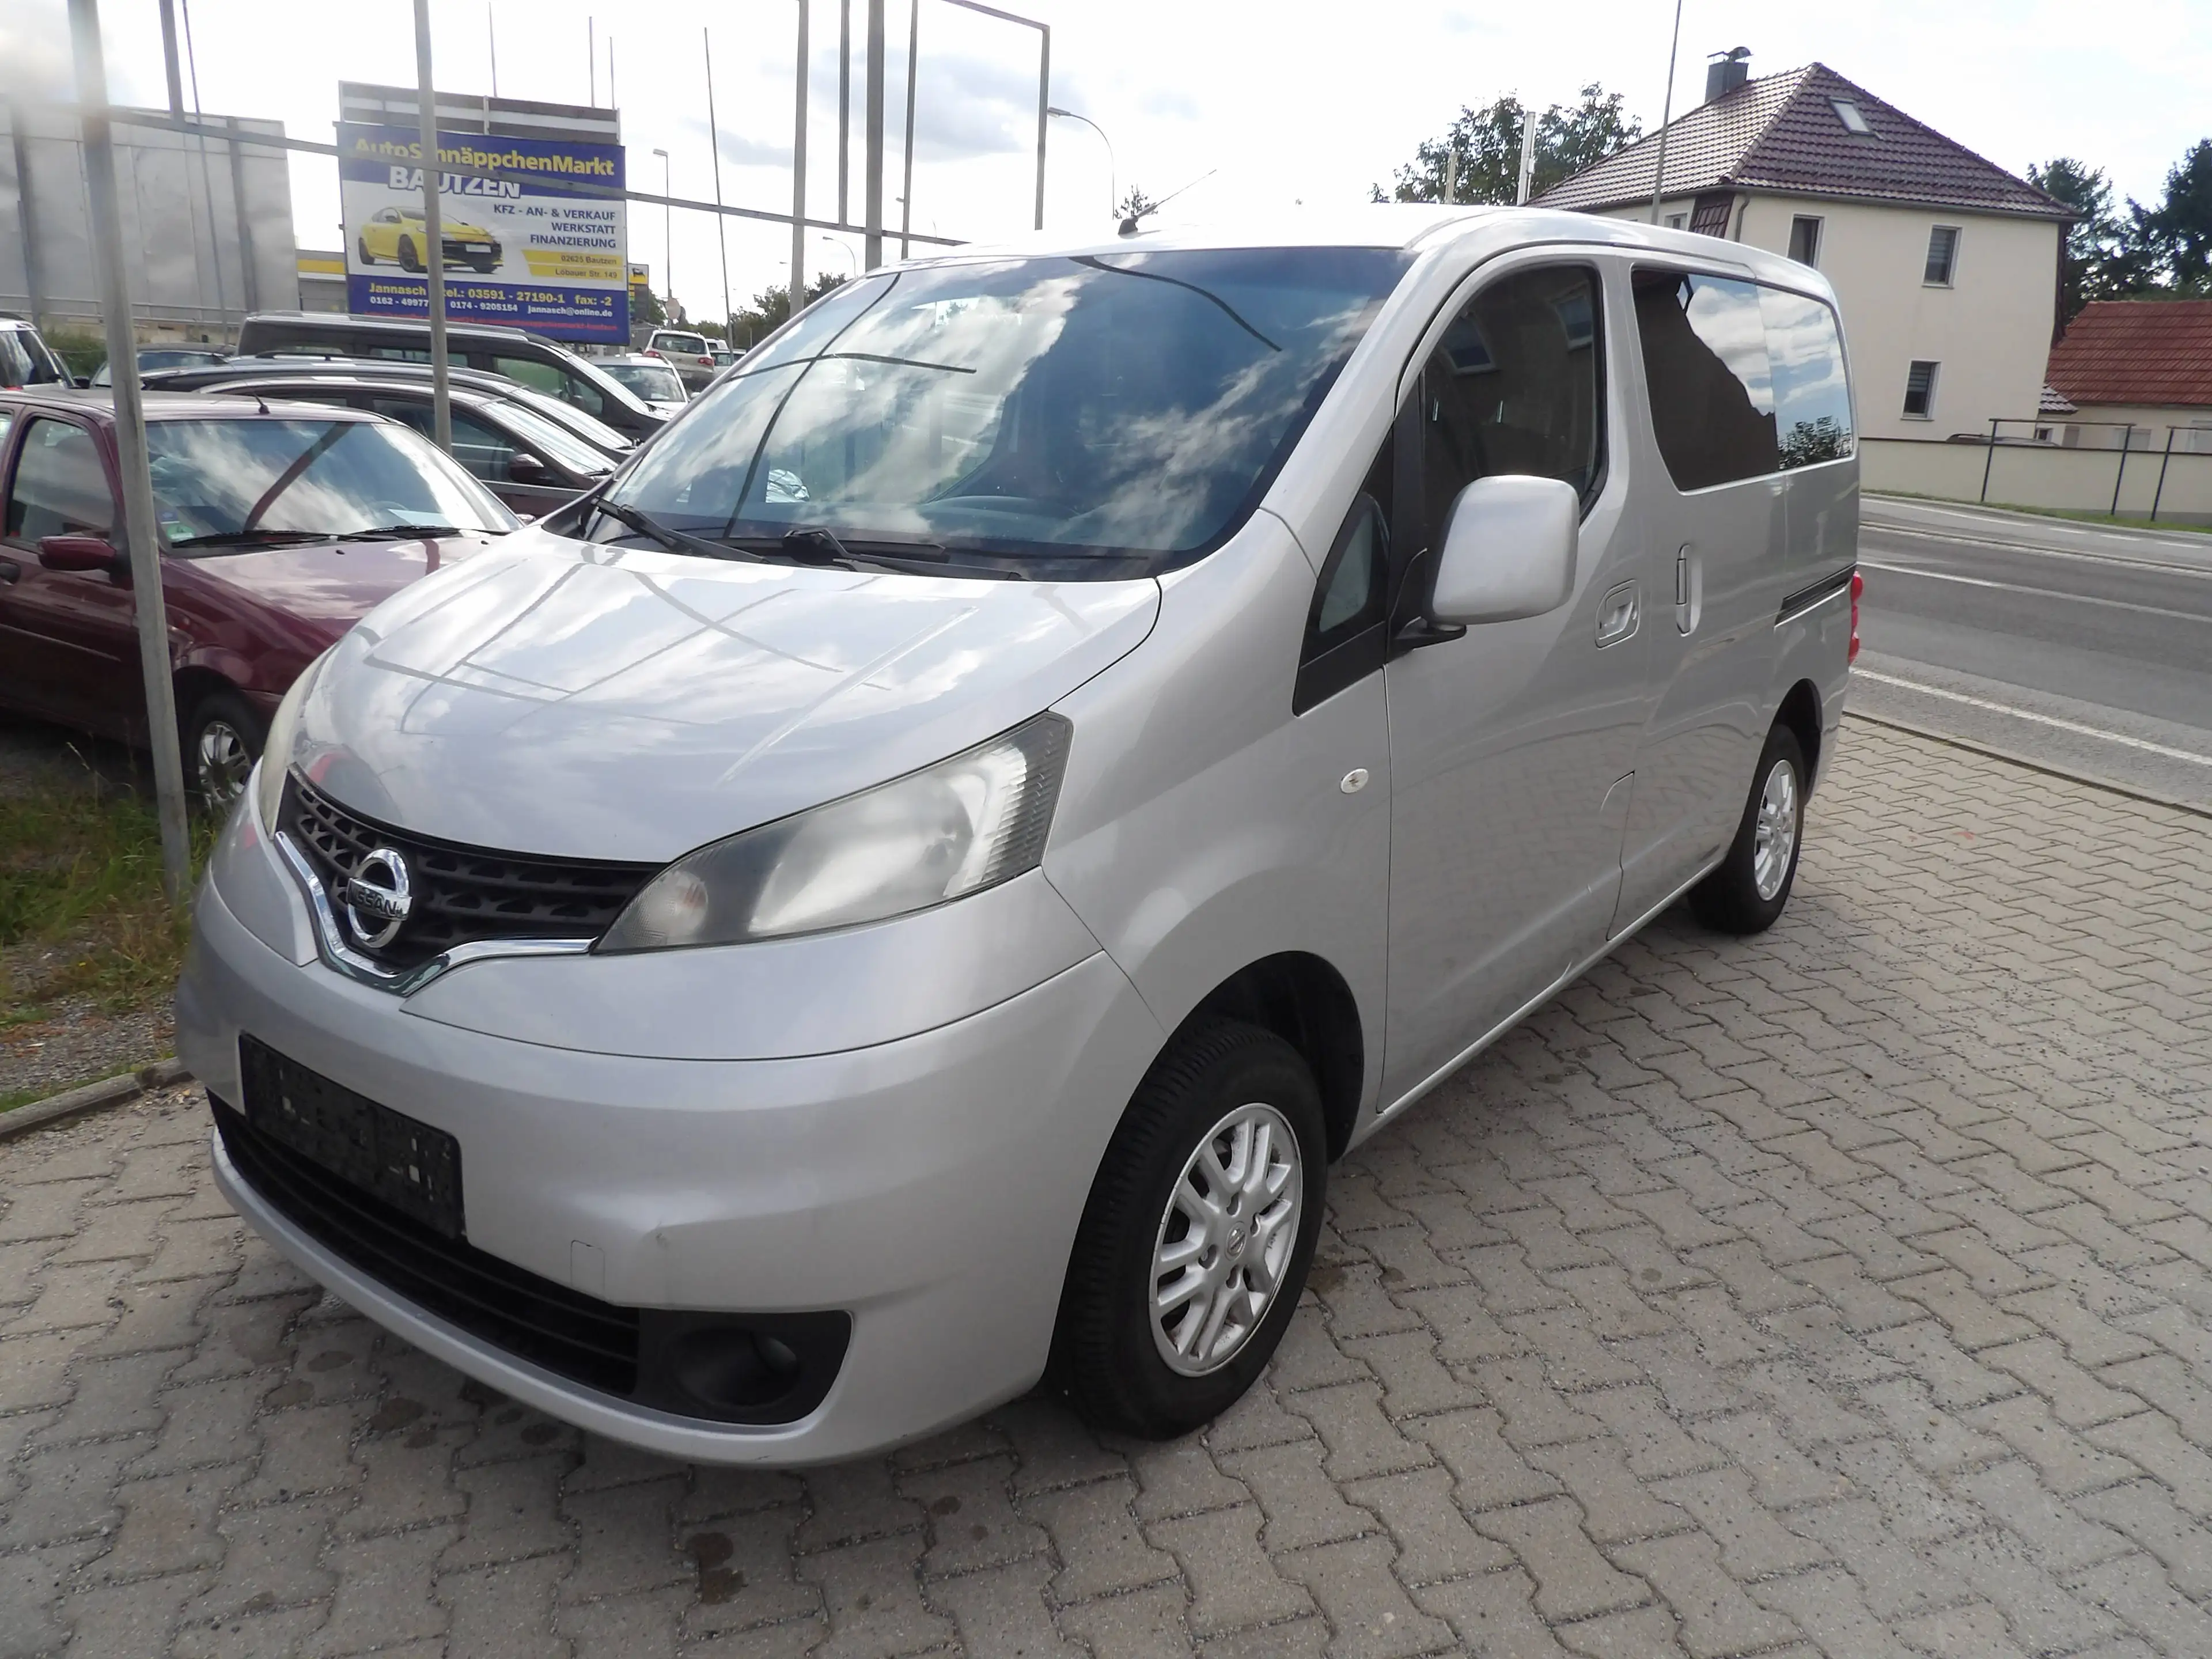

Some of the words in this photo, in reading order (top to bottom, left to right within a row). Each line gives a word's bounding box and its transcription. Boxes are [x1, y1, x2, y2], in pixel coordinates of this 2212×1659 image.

[355, 137, 615, 176] AutoSnäppchenMarkt
[494, 204, 516, 214] KFZ
[526, 207, 548, 217] AN-
[551, 209, 560, 218] &
[563, 209, 616, 221] VERKAUF
[551, 222, 616, 234] WERKSTATT
[531, 234, 616, 248] FINANZIERUNG
[561, 255, 584, 263] 02625
[585, 256, 617, 264] Bautzen
[369, 283, 427, 296] Jannasch
[468, 289, 506, 300] 03591
[517, 291, 565, 304] 27190-1
[575, 294, 597, 306] fax:
[601, 297, 612, 306] -2
[402, 298, 429, 308] 49977
[450, 301, 472, 310] 0174
[527, 305, 613, 317] jannasch@online.de
[350, 887, 398, 917] SSAN
